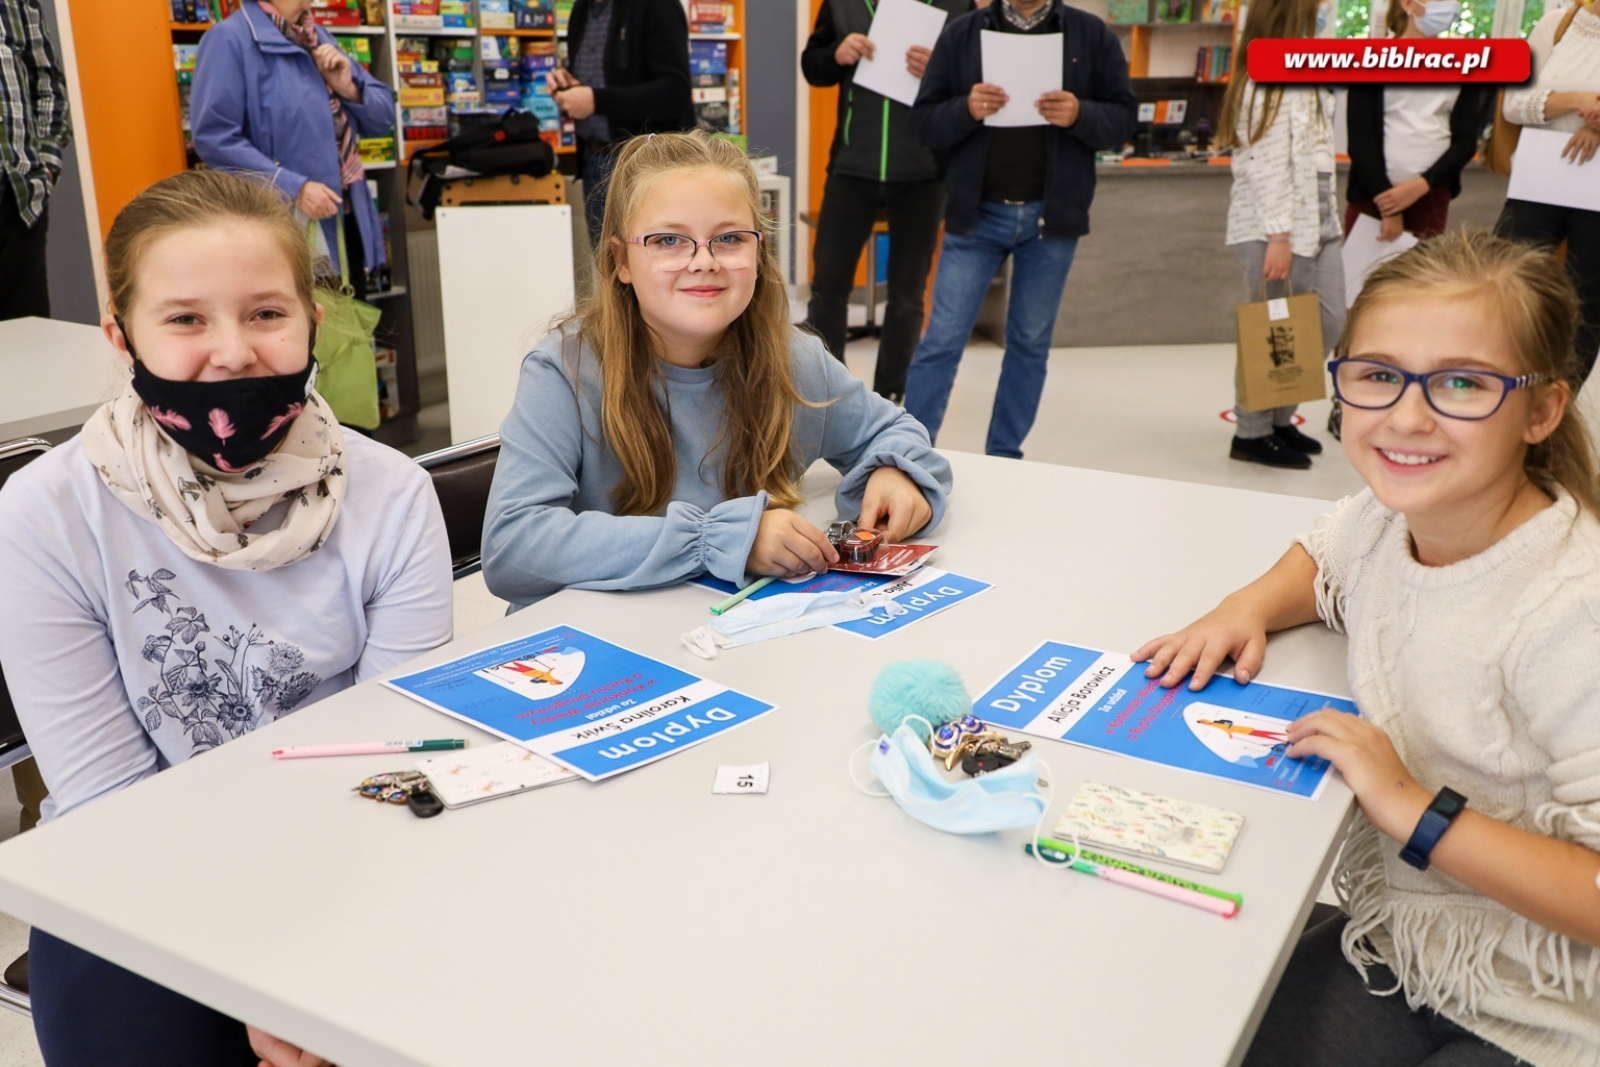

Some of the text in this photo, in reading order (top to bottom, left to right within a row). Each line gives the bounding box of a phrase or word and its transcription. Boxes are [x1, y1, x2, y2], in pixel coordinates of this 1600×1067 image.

[619, 695, 691, 724] Karolina
[990, 656, 1072, 712] Dyplom
[1047, 666, 1116, 723] Alicja Borowicz
[598, 707, 737, 759] Dyplom
[737, 774, 754, 788] 15
